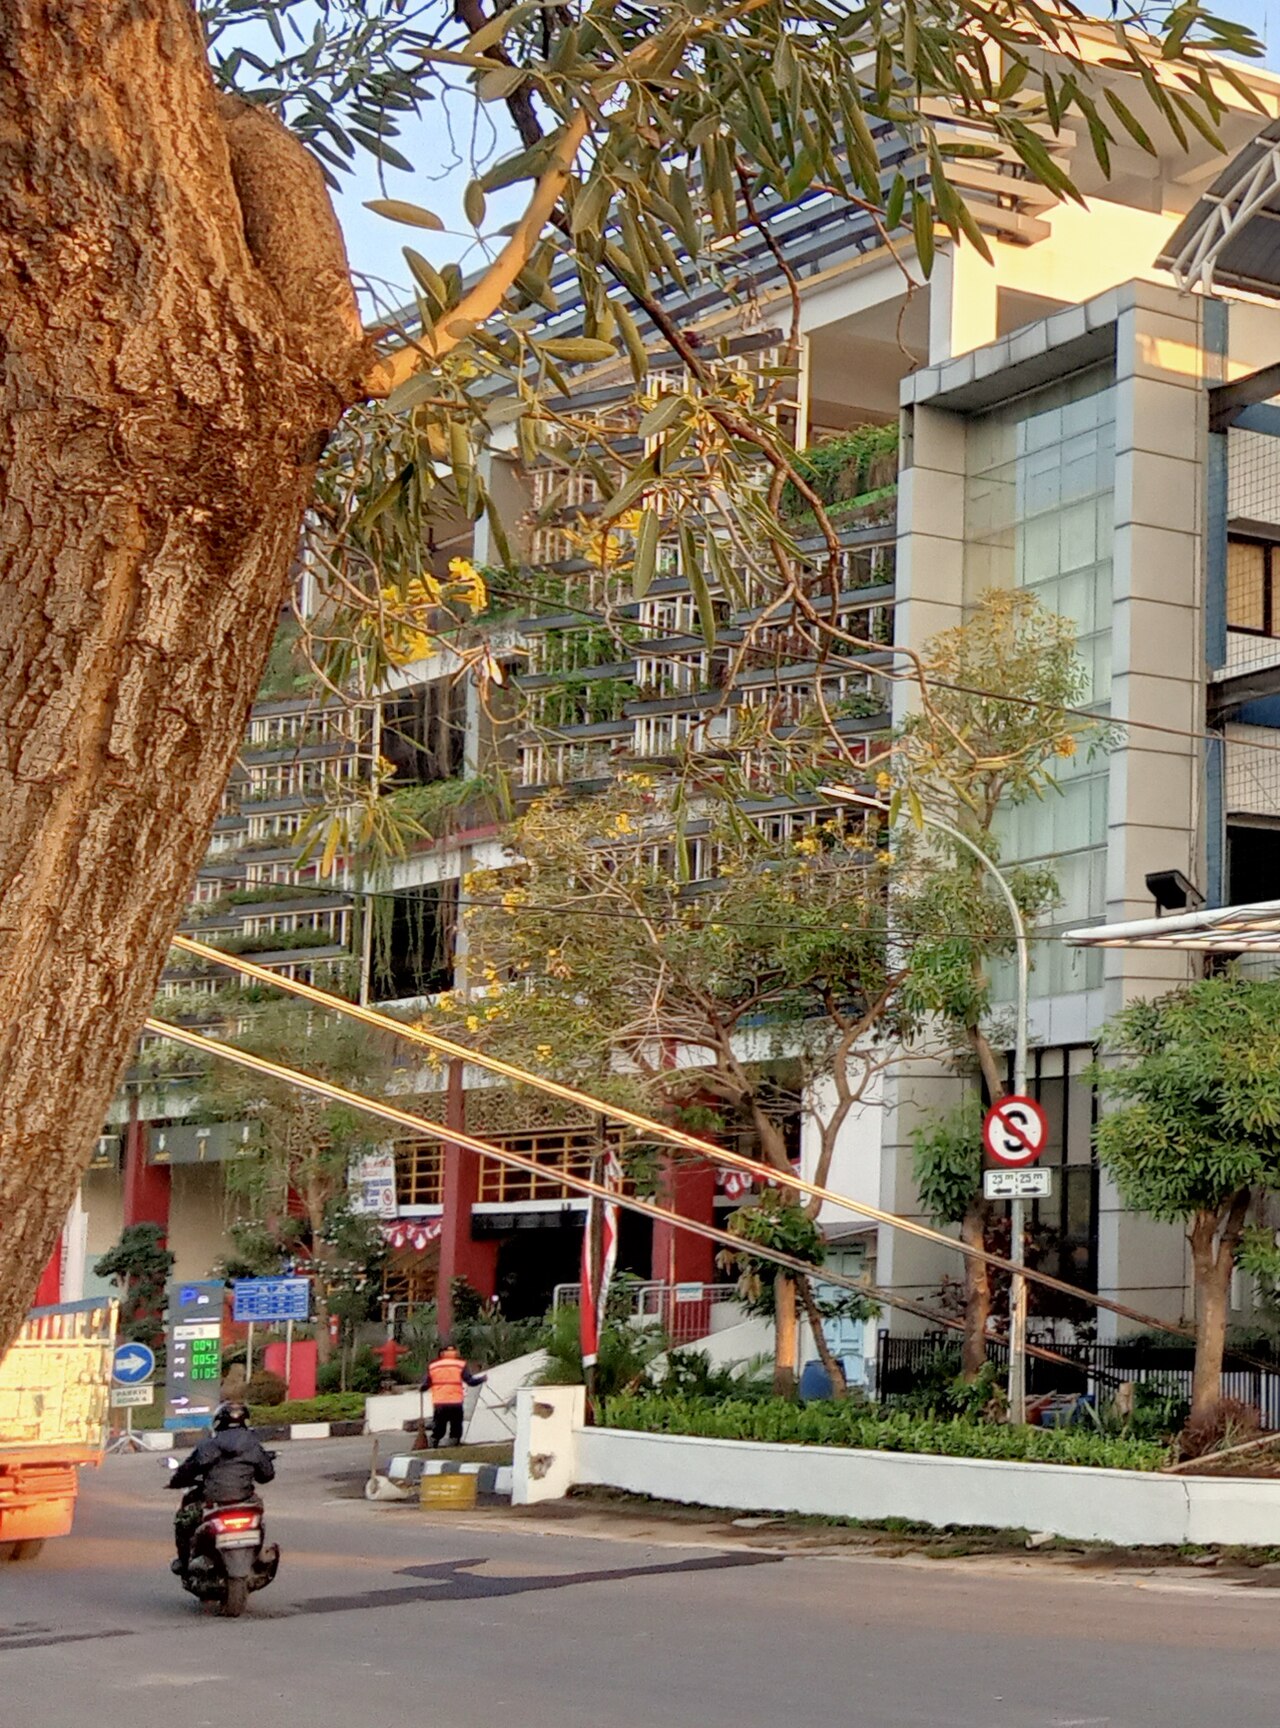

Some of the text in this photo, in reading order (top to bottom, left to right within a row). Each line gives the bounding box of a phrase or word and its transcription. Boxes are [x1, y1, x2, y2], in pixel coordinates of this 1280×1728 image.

[193, 1340, 217, 1351] 0041
[192, 1354, 218, 1365] 0052
[191, 1368, 218, 1379] 0105
